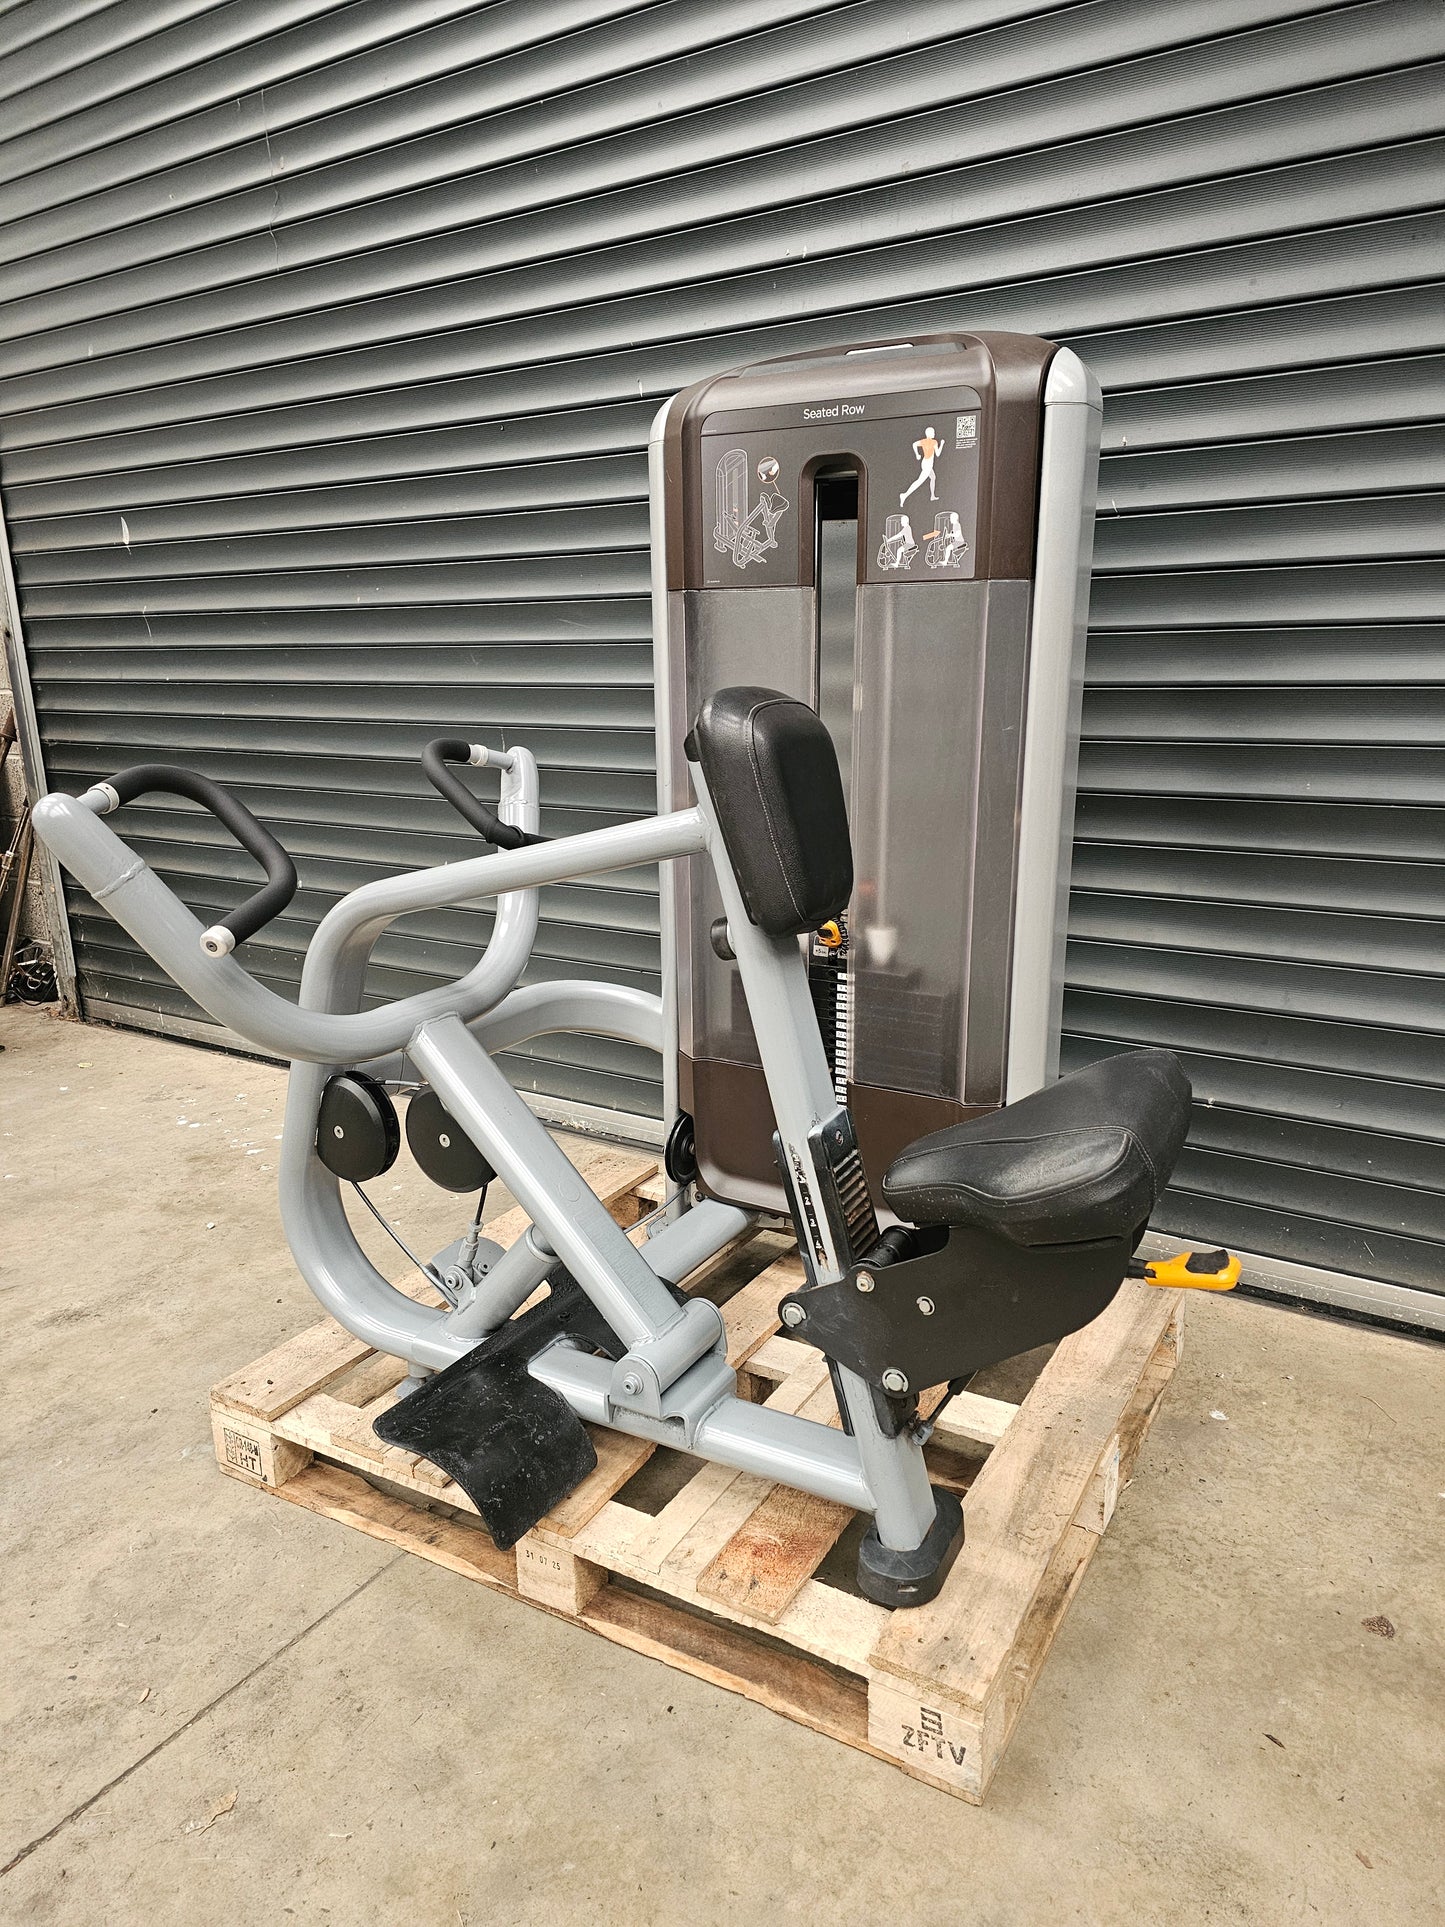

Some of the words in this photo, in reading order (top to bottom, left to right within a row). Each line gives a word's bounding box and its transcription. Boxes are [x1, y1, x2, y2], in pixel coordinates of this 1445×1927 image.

[803, 404, 839, 420] Seated
[841, 404, 866, 416] Row
[804, 1196, 811, 1206] 2
[240, 1452, 257, 1470] HT
[525, 1549, 534, 1560] 31
[551, 1560, 561, 1571] 25
